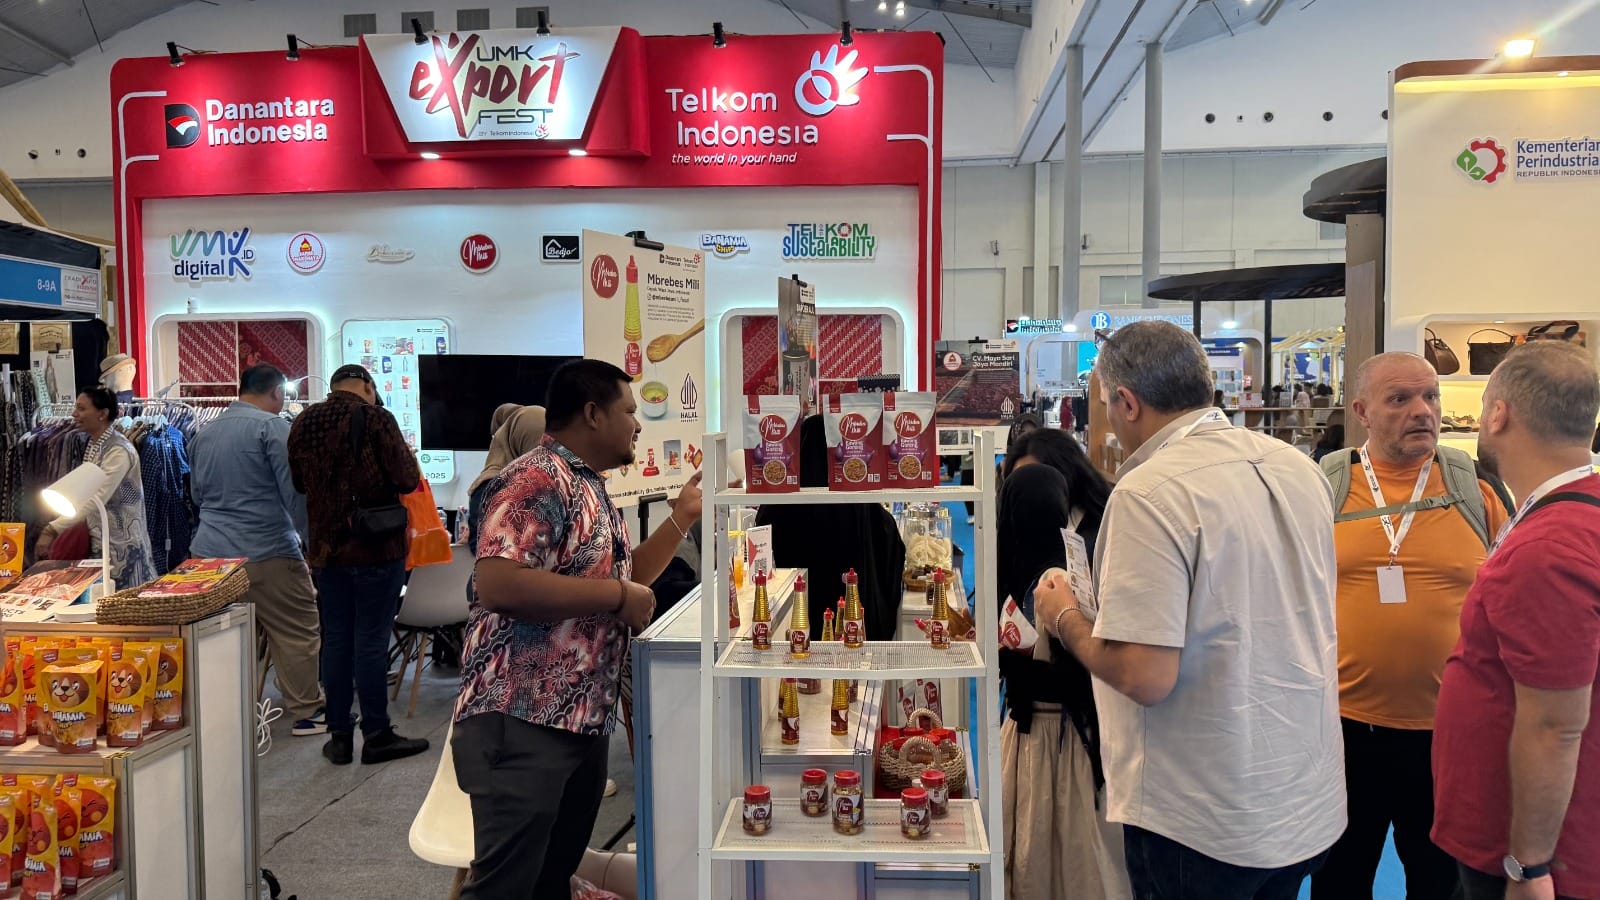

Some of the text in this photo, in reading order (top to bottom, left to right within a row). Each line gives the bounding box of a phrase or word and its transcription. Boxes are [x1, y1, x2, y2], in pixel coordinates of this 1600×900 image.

[477, 45, 534, 61] UMK
[665, 87, 776, 112] Telkom
[205, 97, 335, 121] Danantara
[478, 108, 553, 124] FEST
[207, 120, 327, 146] Indonesia
[677, 120, 818, 146] Indonesia
[672, 152, 797, 166] the world in your hand
[787, 223, 868, 239] TELKOM
[174, 259, 224, 280] digital
[37, 279, 57, 292] 8-9A
[647, 272, 700, 290] Mbrebes Mili
